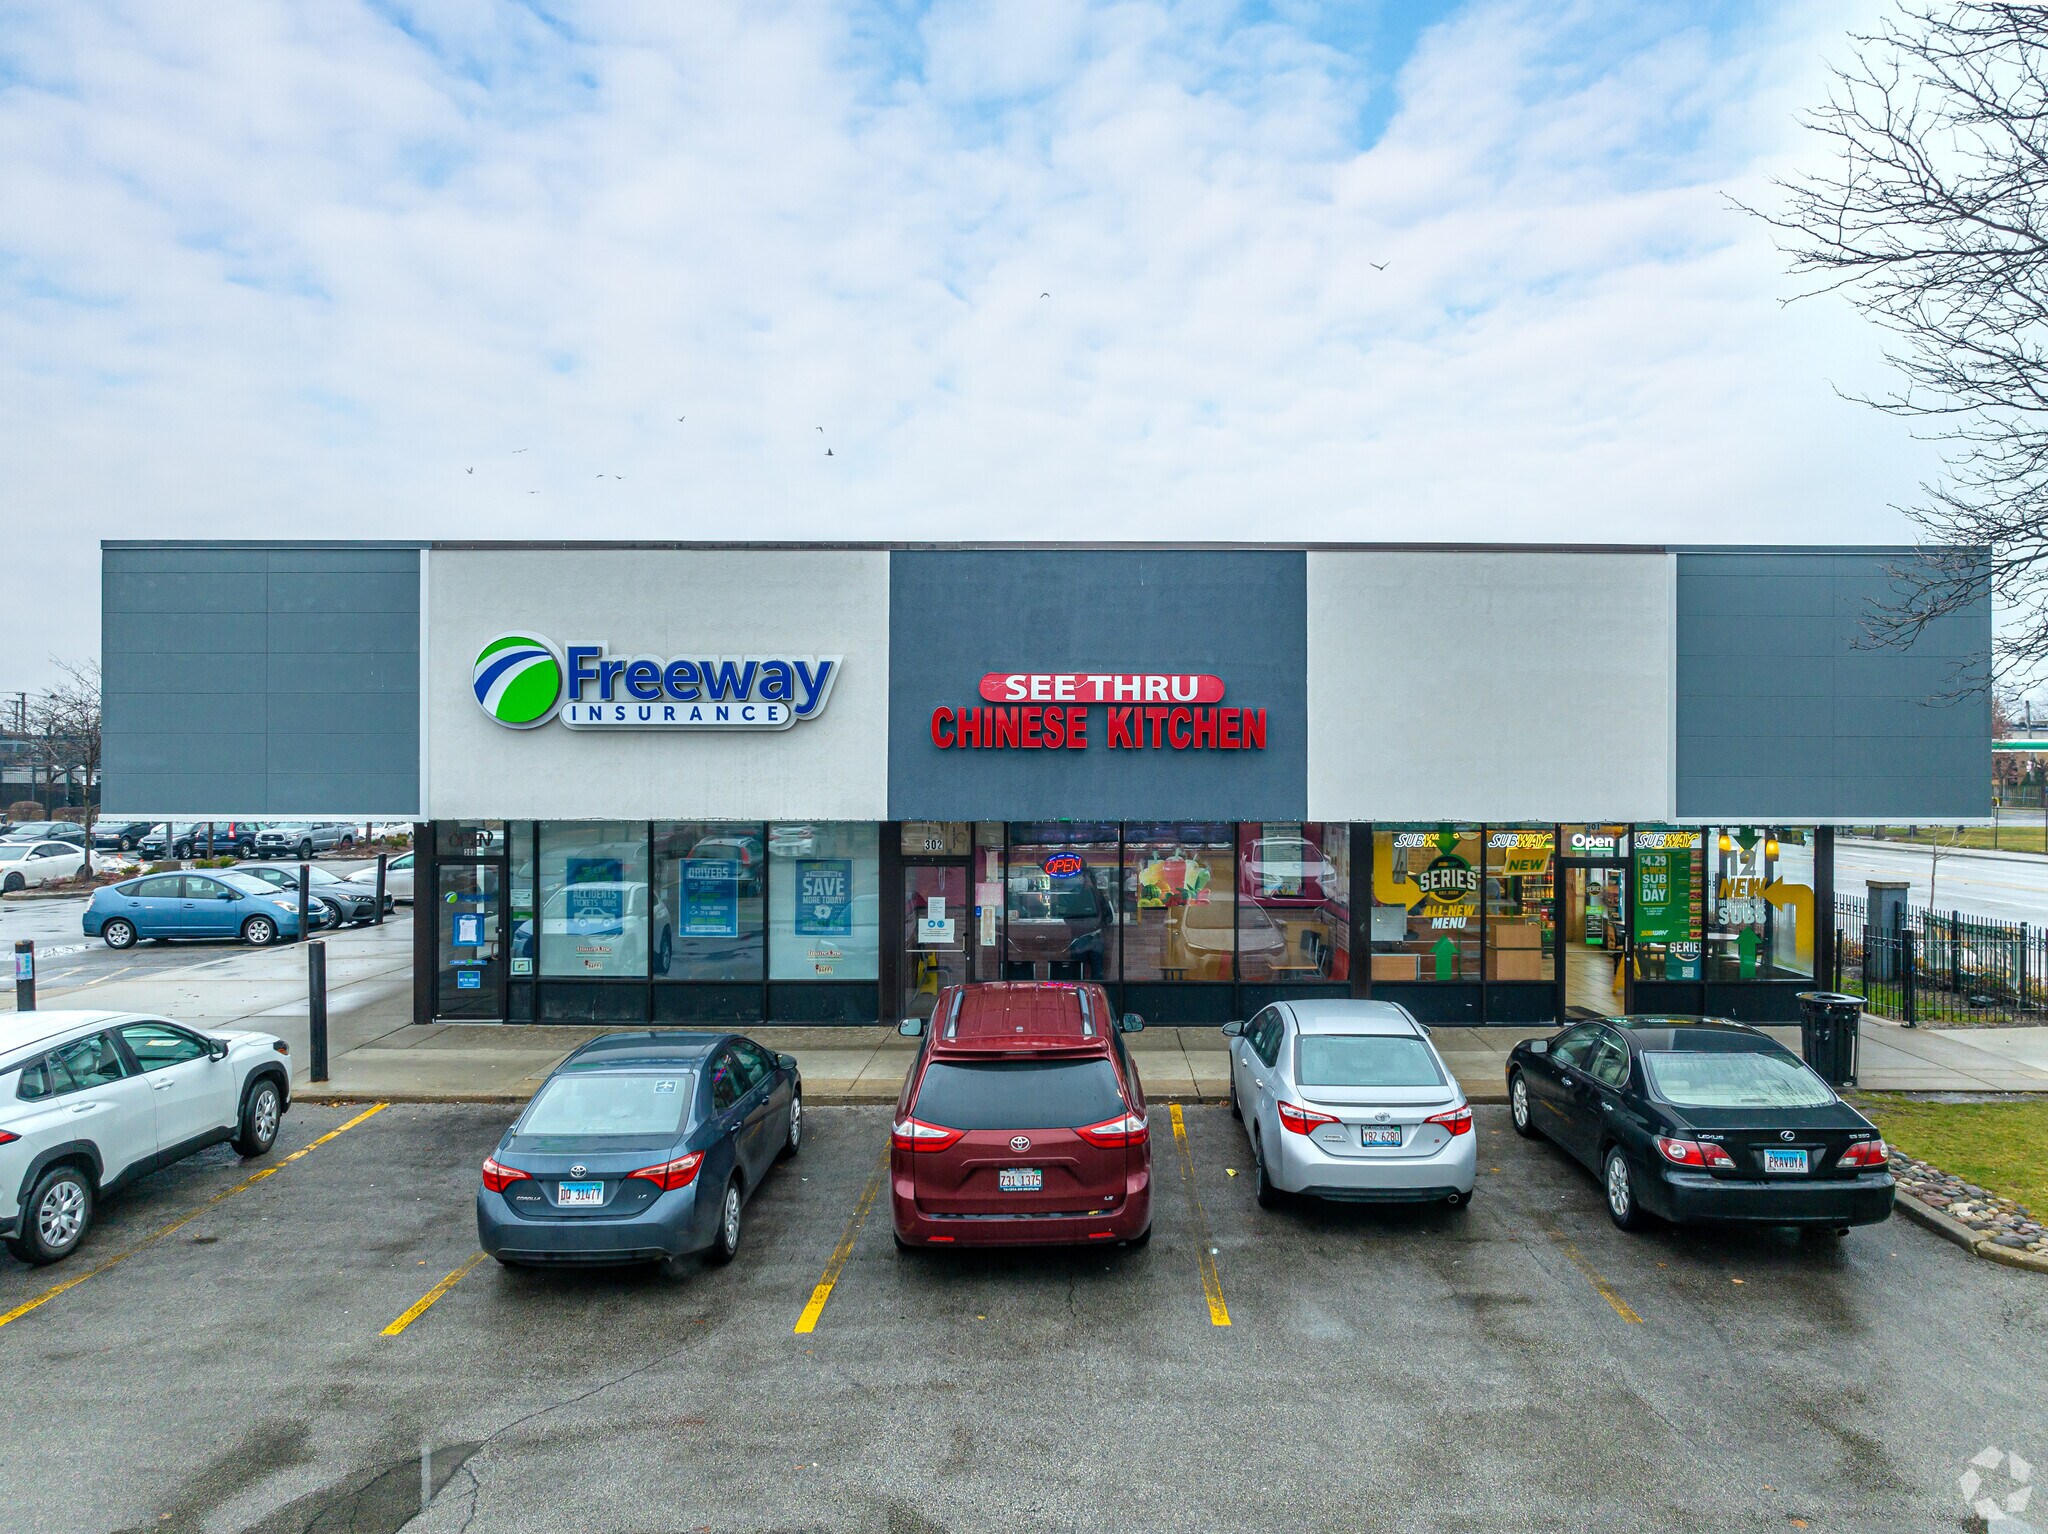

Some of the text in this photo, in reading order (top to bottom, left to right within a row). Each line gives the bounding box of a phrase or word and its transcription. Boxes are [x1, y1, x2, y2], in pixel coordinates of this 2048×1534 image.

[566, 645, 835, 715] Freeway
[1005, 675, 1199, 701] SEE THRU
[571, 706, 779, 721] INSURANCE
[931, 706, 1267, 750] CHINESE KITCHEN
[925, 840, 942, 850] 302
[1394, 833, 1460, 848] SUBW
[1488, 833, 1553, 848] SUBWAY
[1572, 833, 1614, 850] Open
[1635, 833, 1699, 848] SUBWAY
[1045, 857, 1082, 875] OPEN
[1508, 860, 1544, 871] NEW
[1641, 855, 1667, 867] $4.29
[1727, 849, 1757, 876] 12
[688, 867, 729, 878] DRIVERS
[1642, 874, 1667, 884] SUB
[802, 877, 845, 896] SAVE
[1420, 869, 1477, 892] SERIES
[573, 889, 617, 899] ACCIDENTS
[1719, 878, 1768, 898] NEW
[802, 896, 845, 904] MORE TODAY!
[1643, 889, 1666, 902] DAY
[573, 899, 599, 907] TICKETS
[1423, 905, 1475, 917] ALL-NEW
[1719, 907, 1767, 925] SUBS
[1432, 917, 1467, 929] MENU
[1769, 1156, 1804, 1168] PRAVDYA
[1020, 1175, 1041, 1186] 1375
[575, 1188, 601, 1200] 31477
